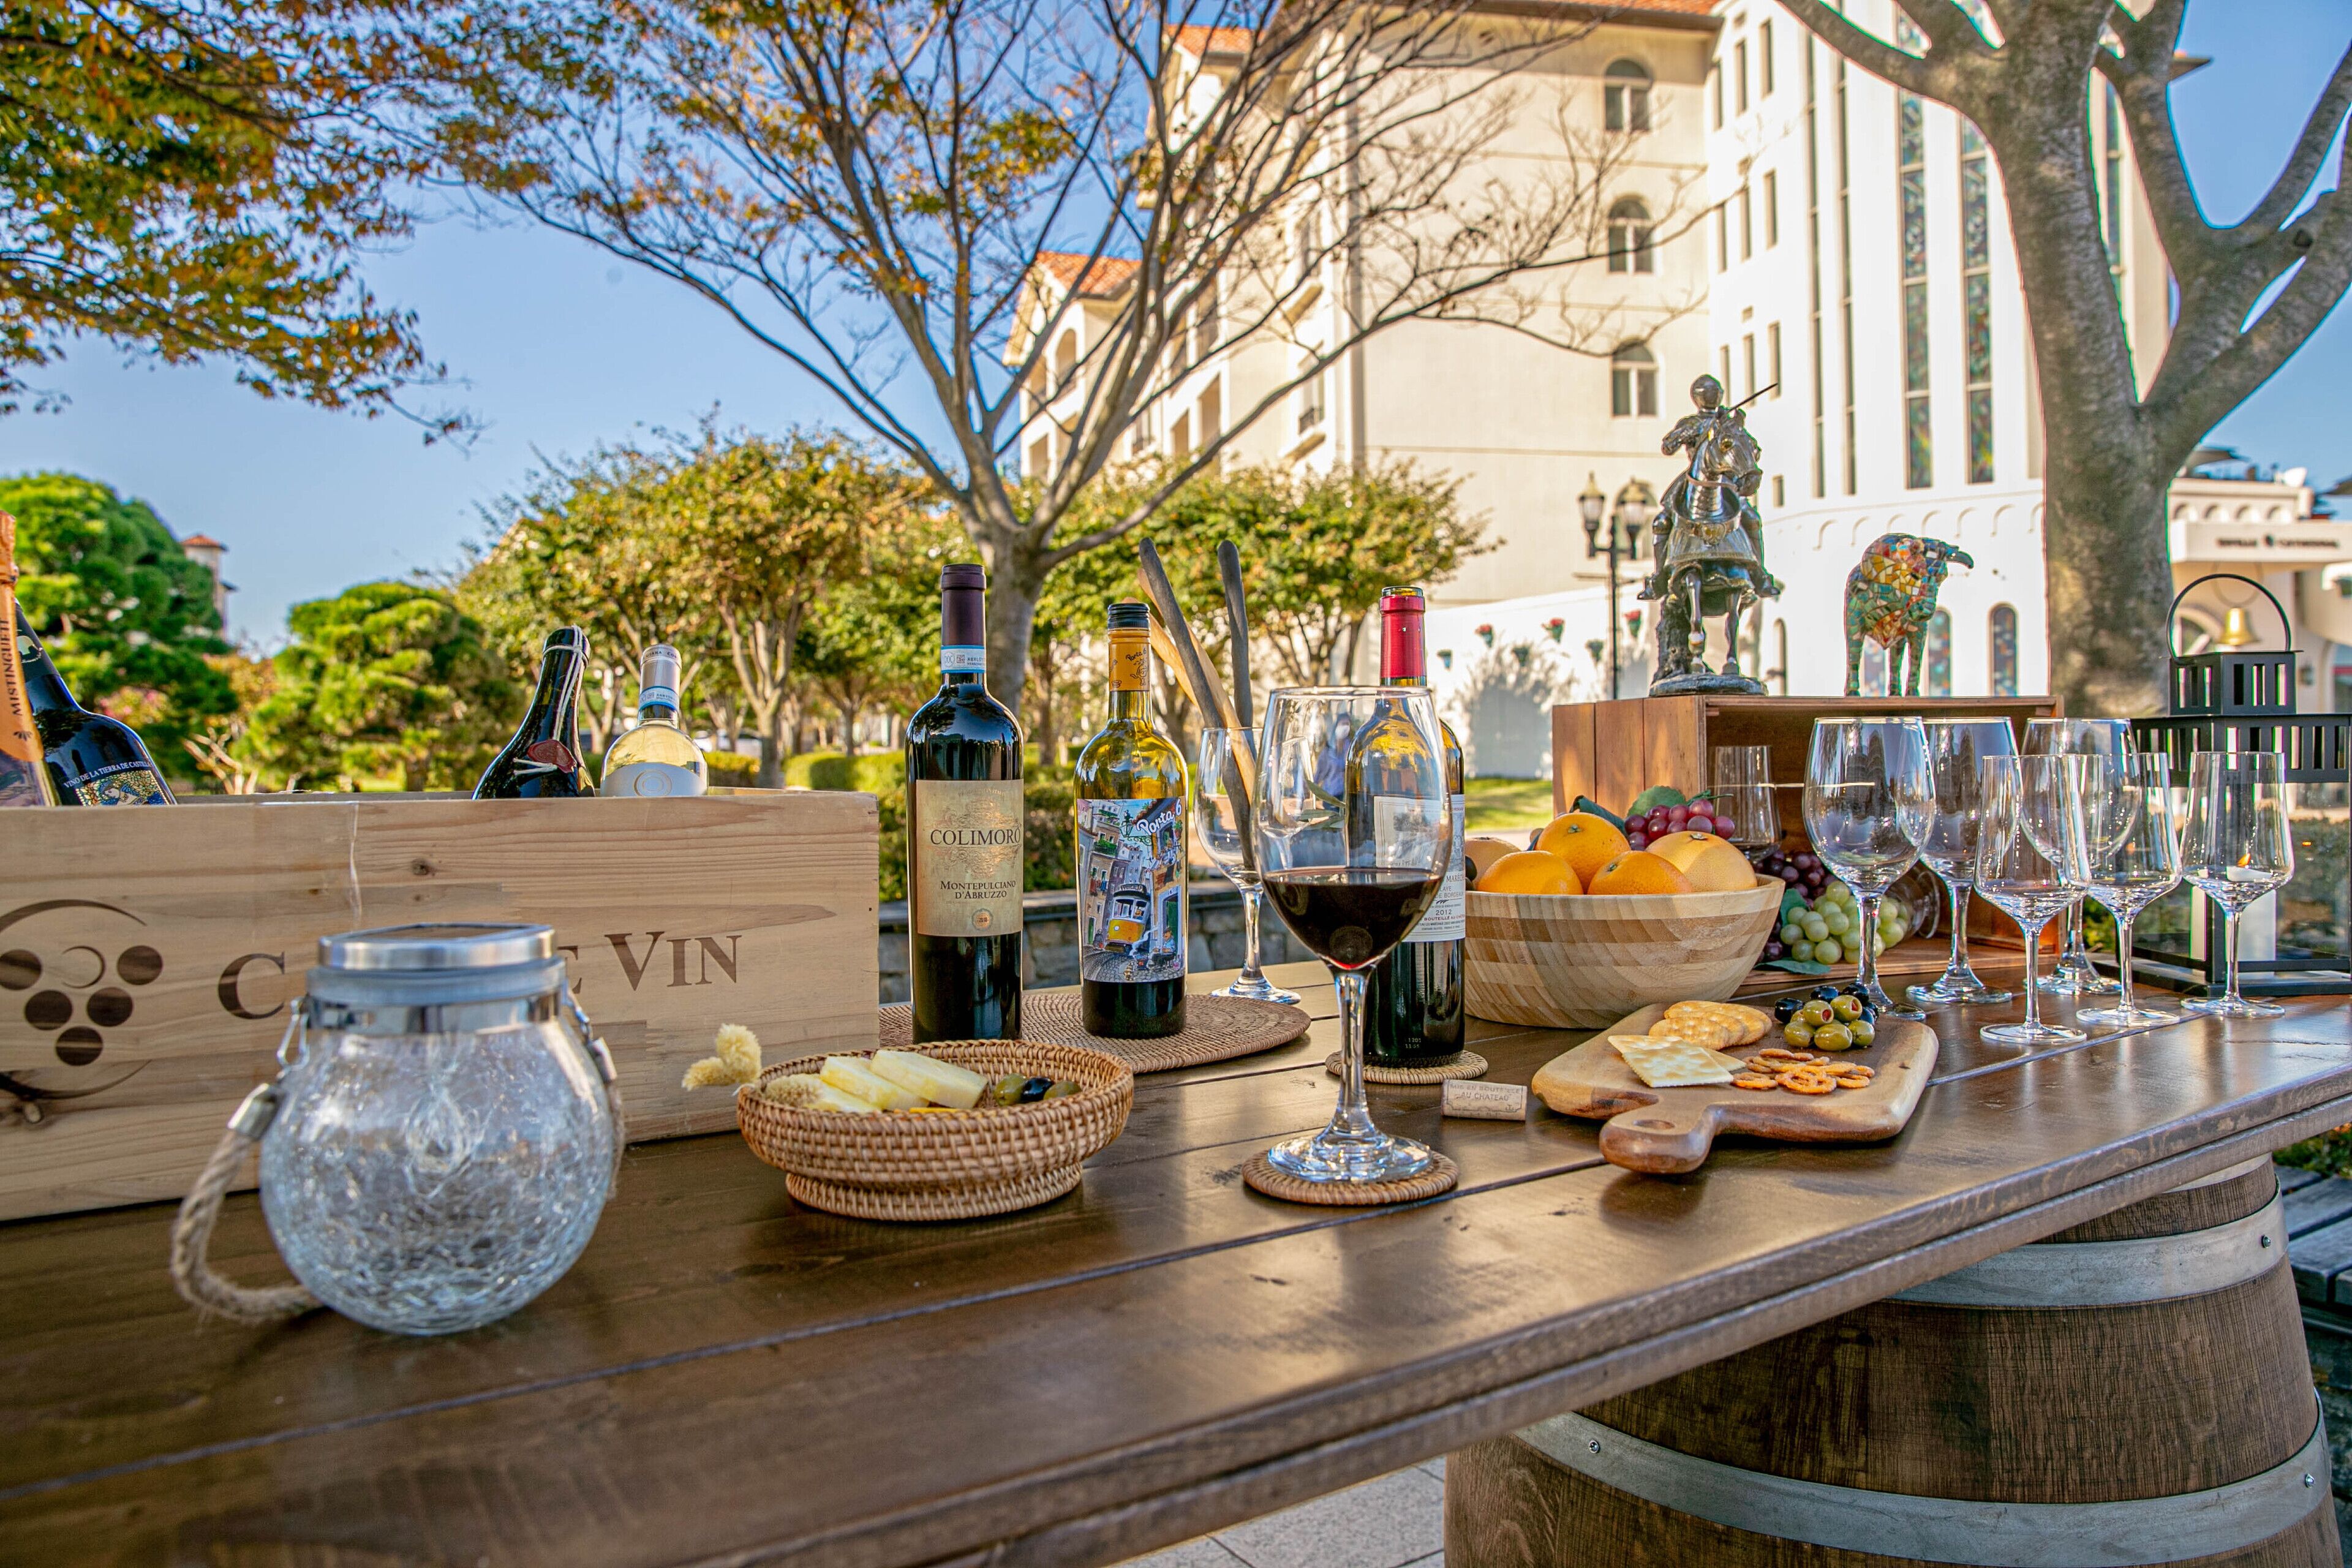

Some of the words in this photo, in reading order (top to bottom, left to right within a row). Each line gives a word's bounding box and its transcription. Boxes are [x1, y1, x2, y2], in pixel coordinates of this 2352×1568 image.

[1125, 652, 1143, 661] Porta
[64, 777, 81, 788] VINO
[80, 773, 90, 782] DE
[89, 769, 100, 778] LA
[98, 765, 122, 775] TIERRA
[1136, 810, 1175, 835] Porta
[1175, 798, 1182, 816] 6
[940, 880, 1017, 890] MONTEPULCIANO
[955, 891, 1008, 899] D'ABRUZZO
[604, 931, 742, 991] VIN
[1474, 1093, 1509, 1101] CHATEAU
